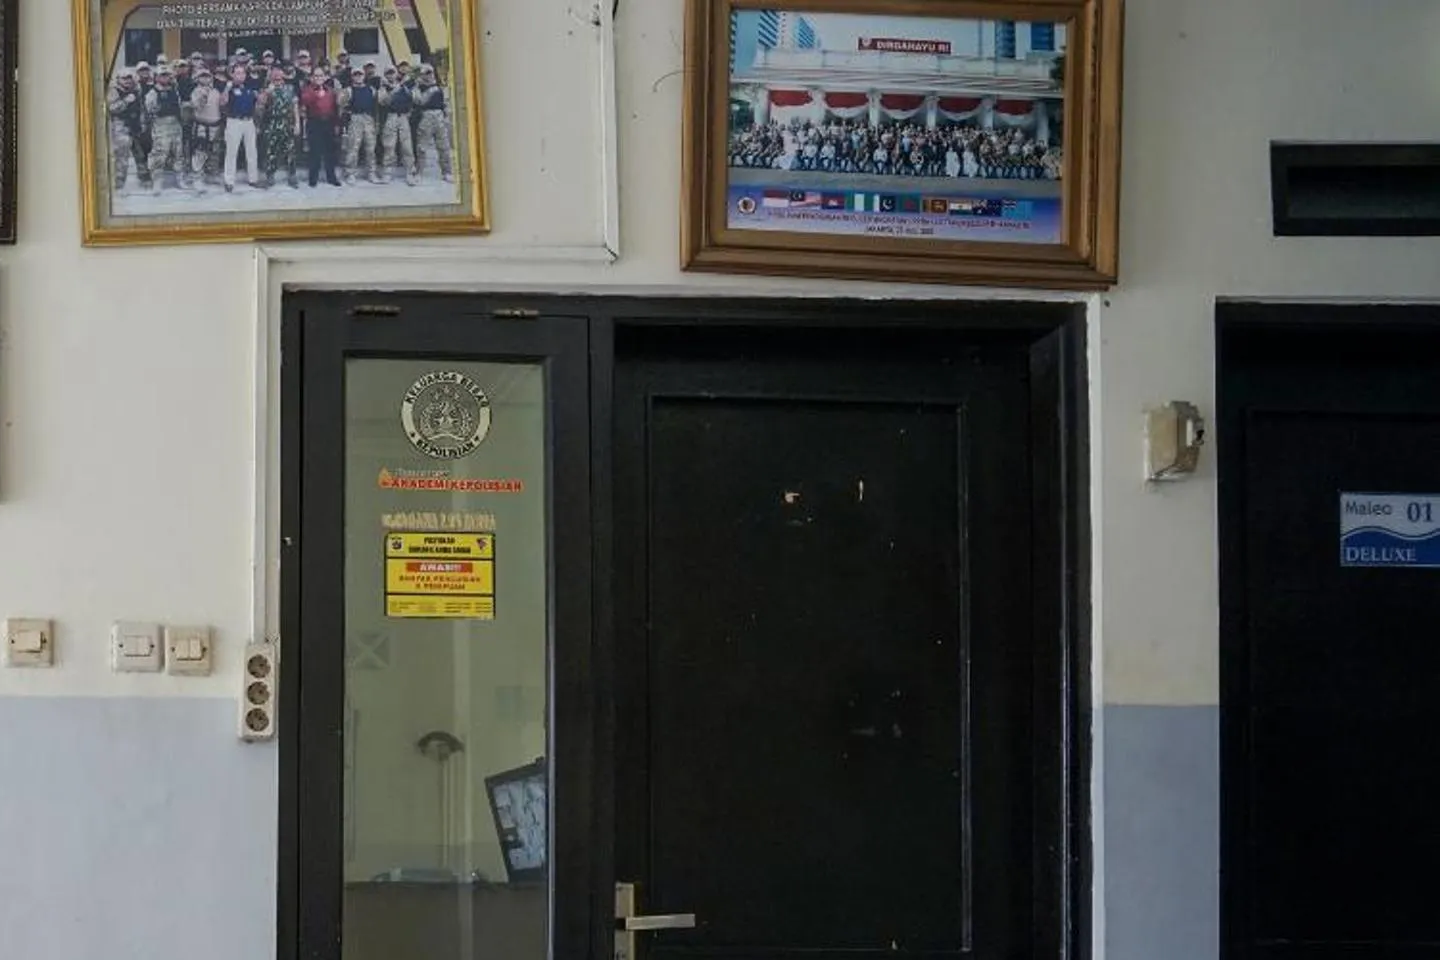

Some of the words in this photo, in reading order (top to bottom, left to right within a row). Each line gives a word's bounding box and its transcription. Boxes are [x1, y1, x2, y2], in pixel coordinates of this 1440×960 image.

[1345, 501, 1393, 515] Maleo
[1406, 502, 1434, 523] 01
[1346, 546, 1417, 562] DELUXE
